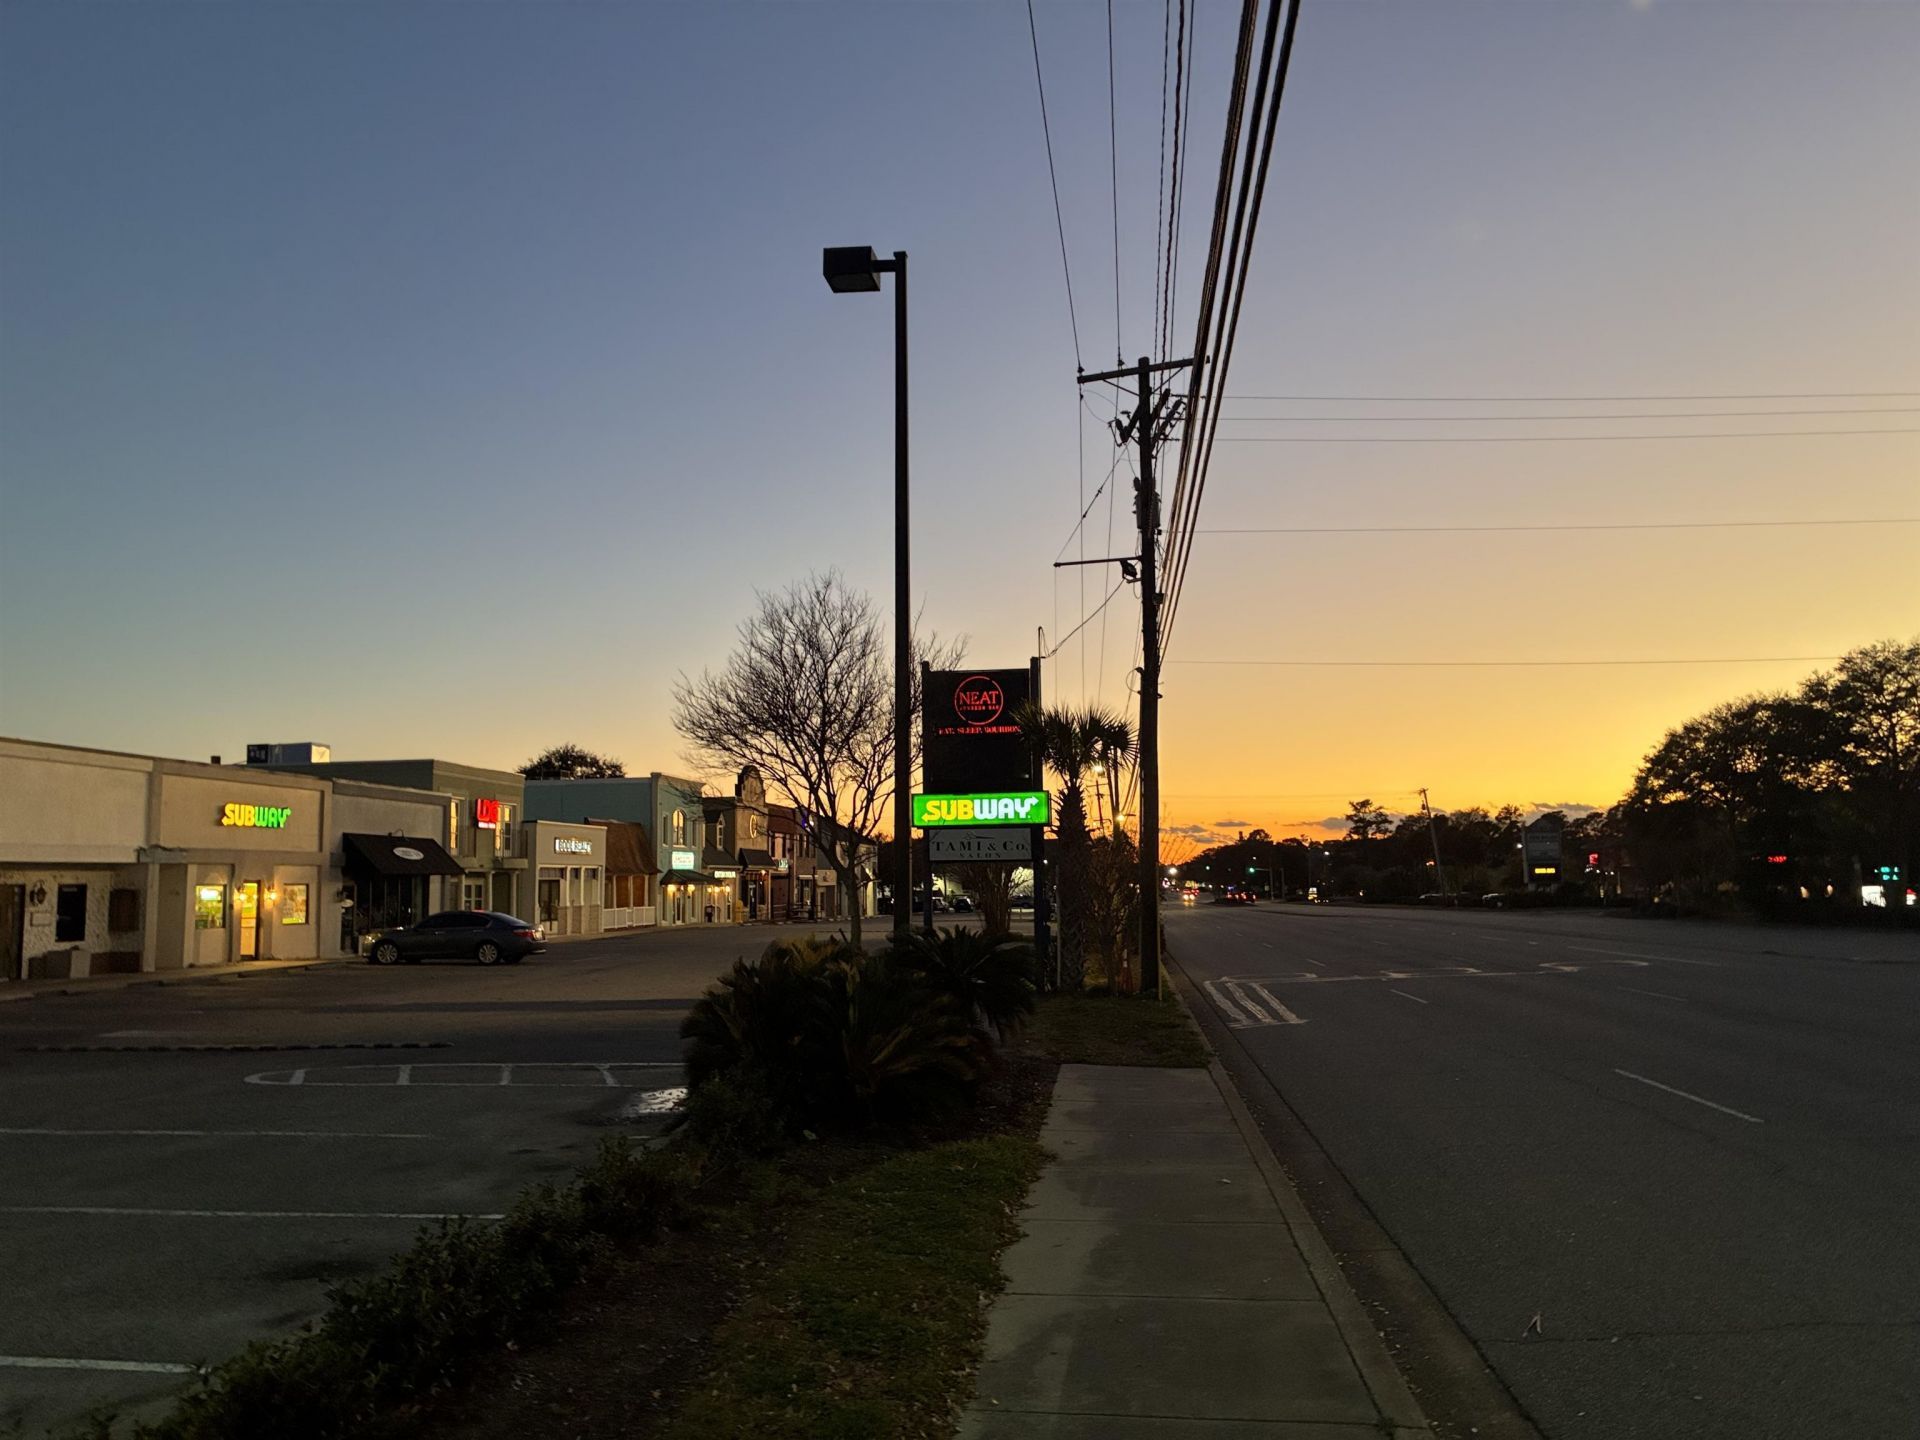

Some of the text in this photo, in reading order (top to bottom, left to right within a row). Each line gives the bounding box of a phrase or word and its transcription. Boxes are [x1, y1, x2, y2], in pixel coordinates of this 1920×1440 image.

[959, 690, 999, 705] NEAT
[221, 803, 291, 829] SUBWAY
[921, 795, 1040, 822] SUBWAY
[932, 840, 982, 852] TAMI
[987, 841, 998, 852] &
